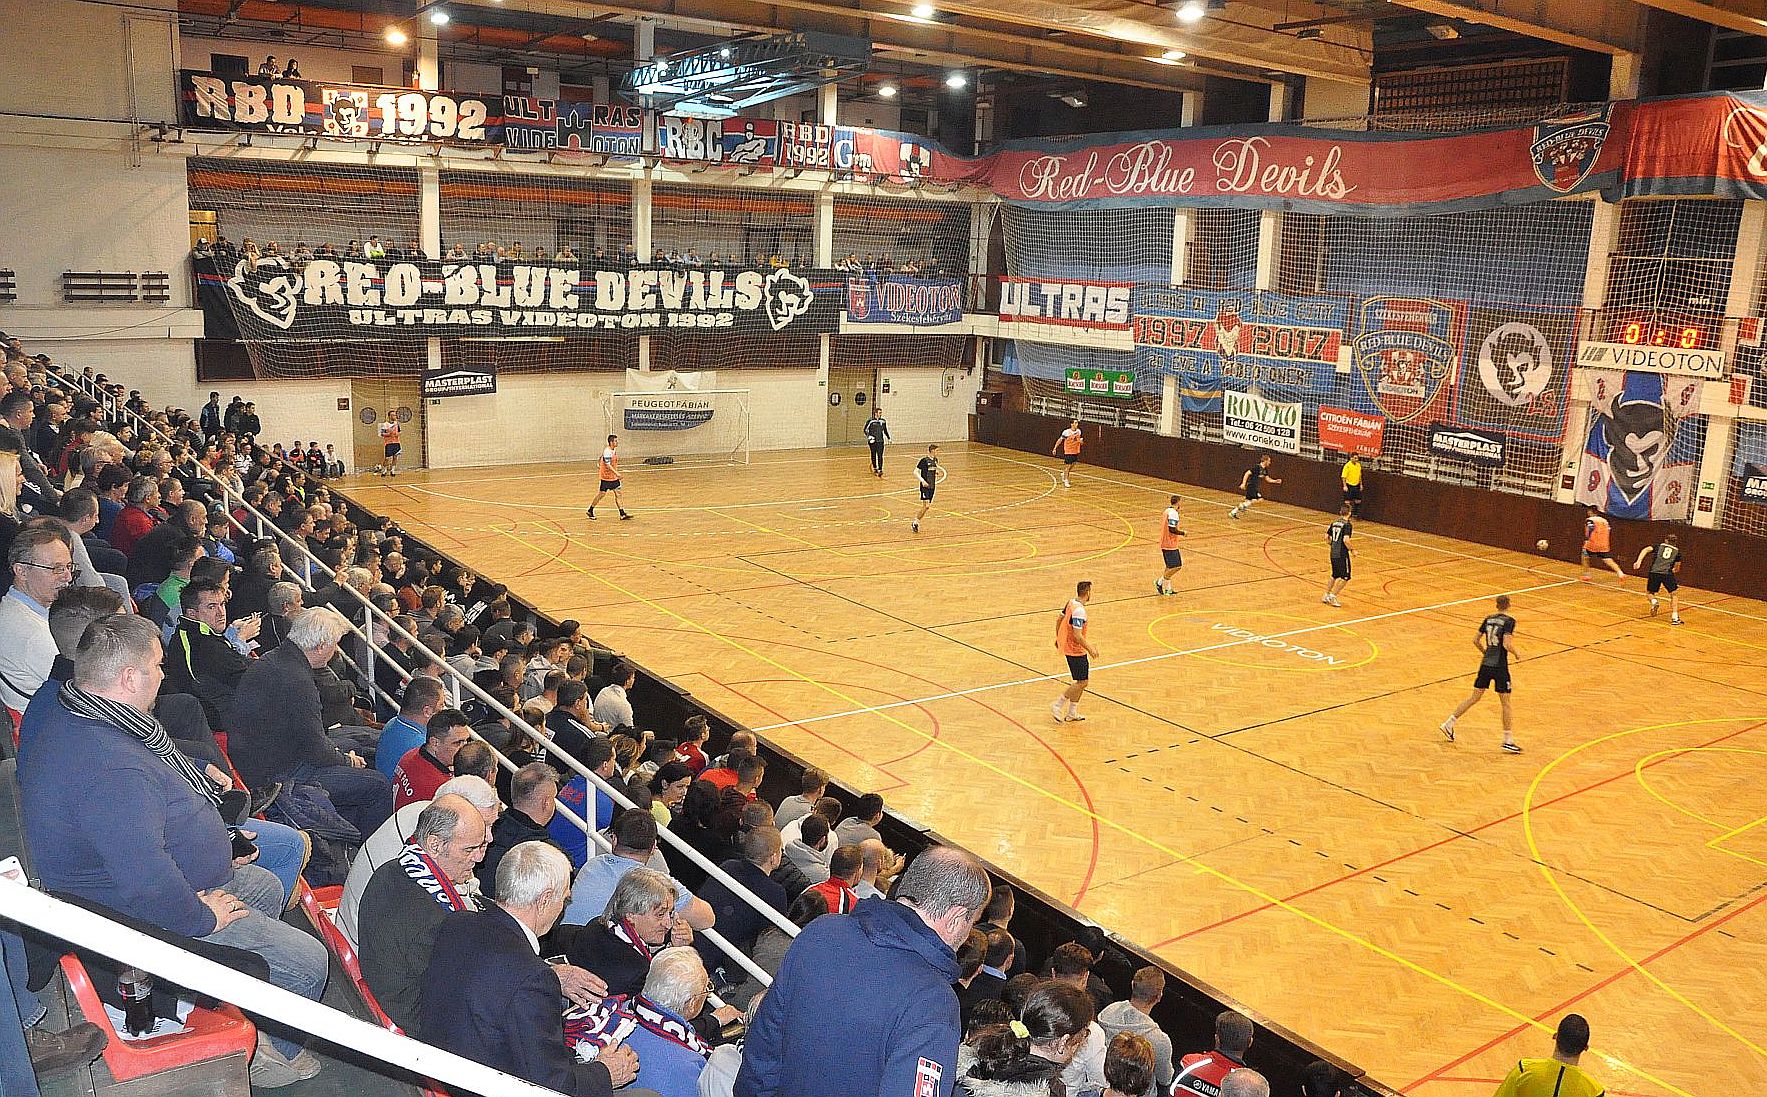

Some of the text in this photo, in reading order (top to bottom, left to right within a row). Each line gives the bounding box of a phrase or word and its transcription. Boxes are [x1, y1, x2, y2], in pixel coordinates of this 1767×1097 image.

[191, 75, 305, 124] RBD
[375, 92, 488, 140] 1992
[783, 122, 829, 143] RBD
[786, 143, 828, 165] 1992
[1019, 136, 1358, 200] Red-Blue Devils
[303, 259, 764, 311] RED-BLUE DEVILS
[876, 281, 961, 314] VIDEOTON
[1001, 281, 1131, 323] ULTRAS
[348, 308, 735, 329] ULTRAS VIDEOTON 1992
[1138, 317, 1331, 361] 1997 2017
[1612, 348, 1723, 373] VIDEOTON
[425, 375, 494, 388] MASTERPLAST
[631, 399, 675, 408] PEUGEOT
[1227, 394, 1297, 427] RONEKO
[1225, 428, 1296, 450] www.roneko.hu
[1432, 433, 1503, 454] MASTERPLAST
[1332, 526, 1342, 542] 17
[1662, 546, 1673, 560] 8
[1211, 622, 1347, 666] VIDEOTON
